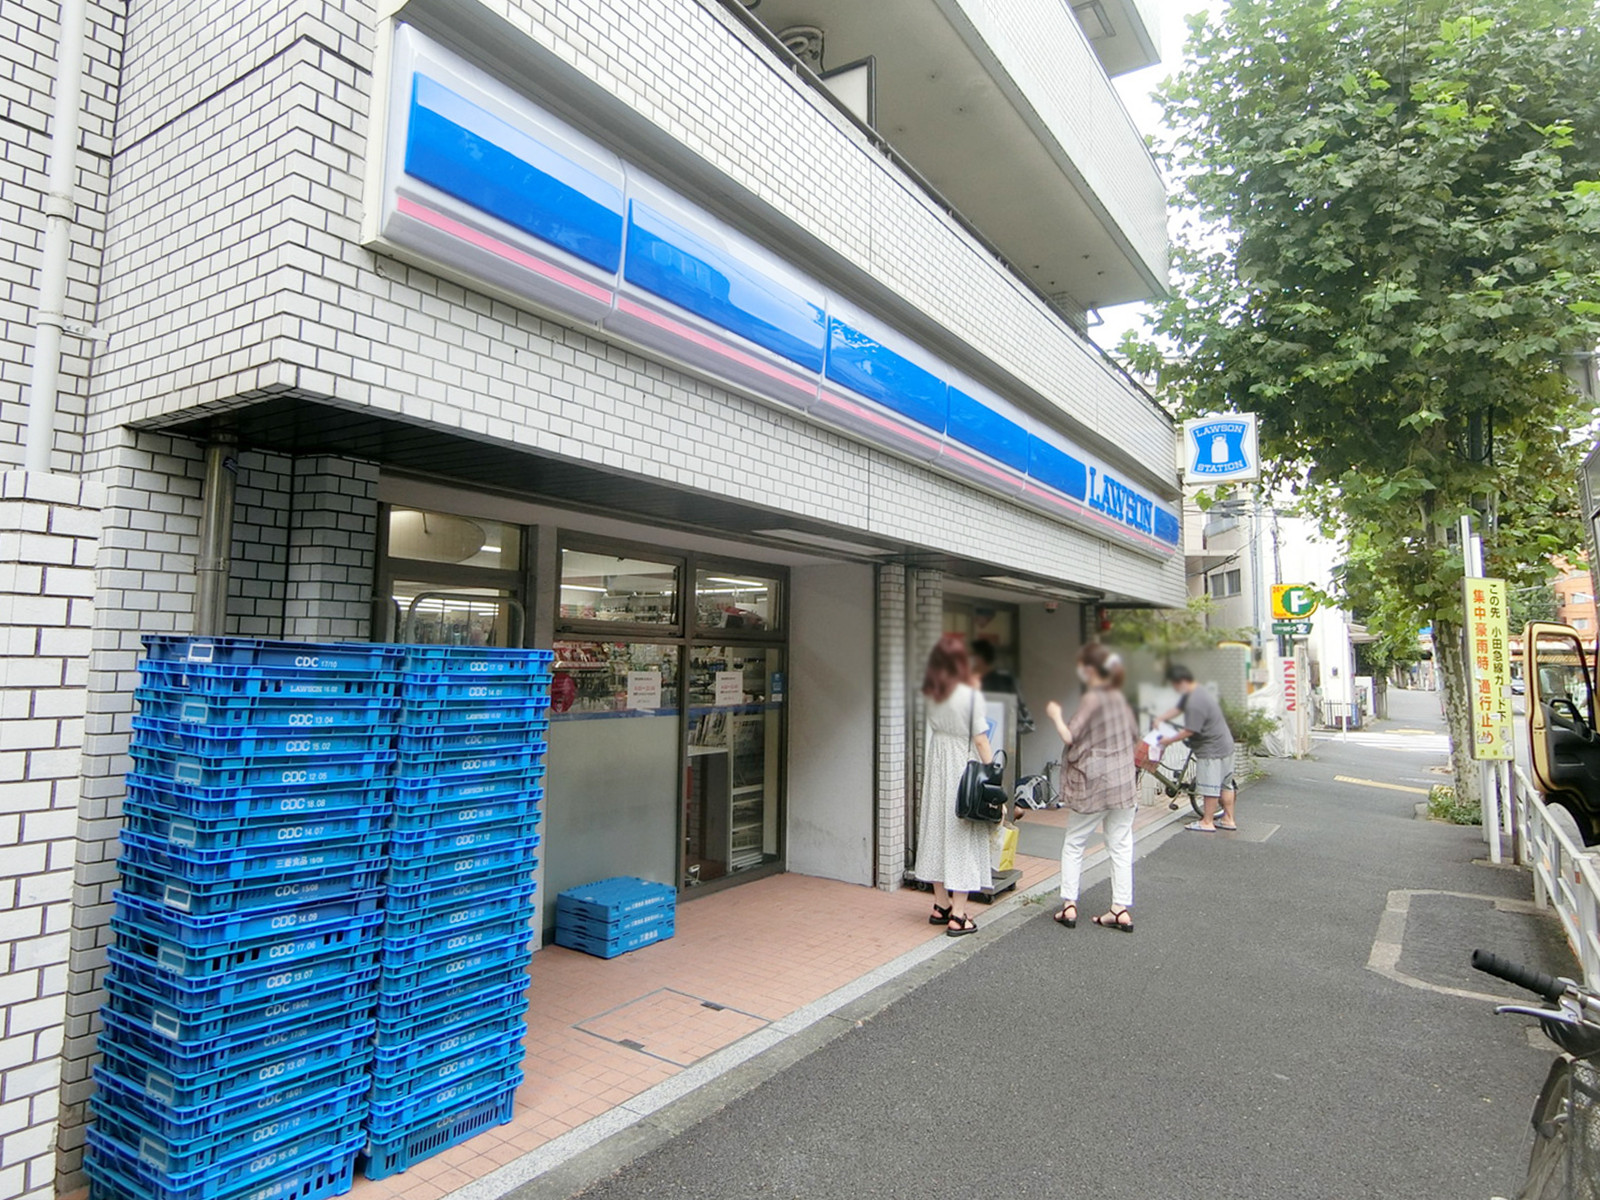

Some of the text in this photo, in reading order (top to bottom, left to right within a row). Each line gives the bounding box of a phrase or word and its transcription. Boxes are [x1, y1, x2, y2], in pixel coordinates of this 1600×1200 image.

[1195, 424, 1243, 437] LAWSON
[1197, 460, 1243, 472] STATION
[1089, 466, 1153, 534] LAWSON
[1490, 584, 1500, 619] この先
[1472, 589, 1489, 670] 集中豪雨時
[295, 656, 319, 667] CDC
[470, 661, 488, 671] CDC
[469, 686, 487, 696] CDC
[288, 714, 313, 725] CDC
[286, 740, 310, 752] CDC
[462, 759, 481, 770] CDC
[282, 770, 307, 782] CDC
[281, 798, 305, 811] CDC
[459, 809, 477, 820] CDC
[278, 826, 303, 840] CDC
[456, 834, 475, 846] CDC
[454, 859, 474, 871] CDC
[275, 884, 300, 897] CDC
[271, 914, 296, 928] CDC
[450, 910, 468, 923] CDC
[448, 935, 467, 949] CDC
[269, 943, 295, 958] CDC
[446, 960, 465, 973] CDC
[266, 973, 292, 988] CDC
[265, 1002, 290, 1017] CDC
[264, 1032, 288, 1046] CDC
[440, 1037, 459, 1052] CDC
[259, 1062, 285, 1080] CDC
[439, 1062, 458, 1077] CDC
[257, 1092, 282, 1108] CDC
[437, 1087, 456, 1103] CDC
[253, 1123, 278, 1142] CDC
[250, 1153, 277, 1173] CDC
